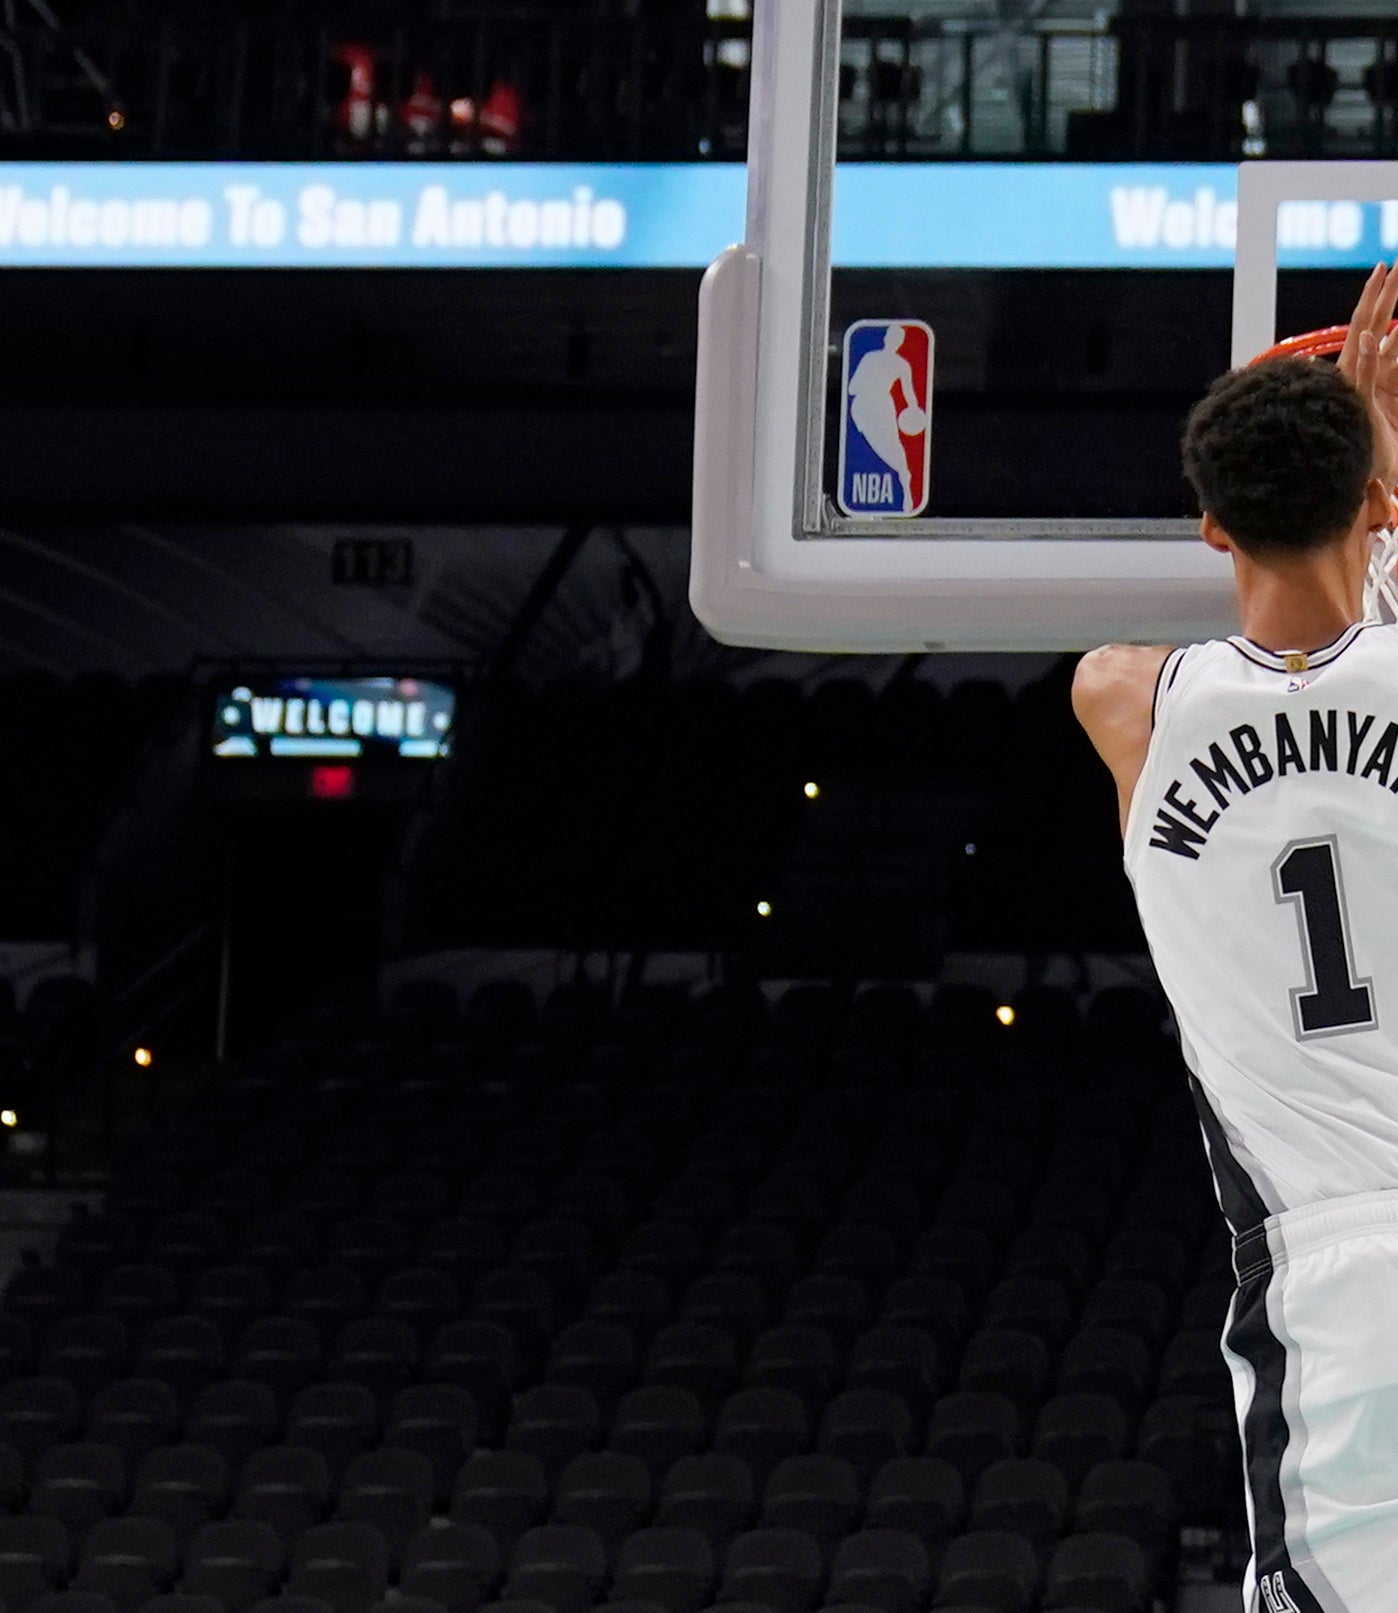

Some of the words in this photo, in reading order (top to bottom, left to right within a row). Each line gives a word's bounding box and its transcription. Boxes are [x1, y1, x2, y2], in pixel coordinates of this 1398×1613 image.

[223, 185, 286, 248] To
[298, 184, 402, 249] San
[412, 184, 627, 249] Antonio
[1109, 186, 1363, 250] Welcme
[852, 472, 894, 504] NBA
[250, 697, 427, 738] WELCOME
[1270, 833, 1380, 1042] 1
